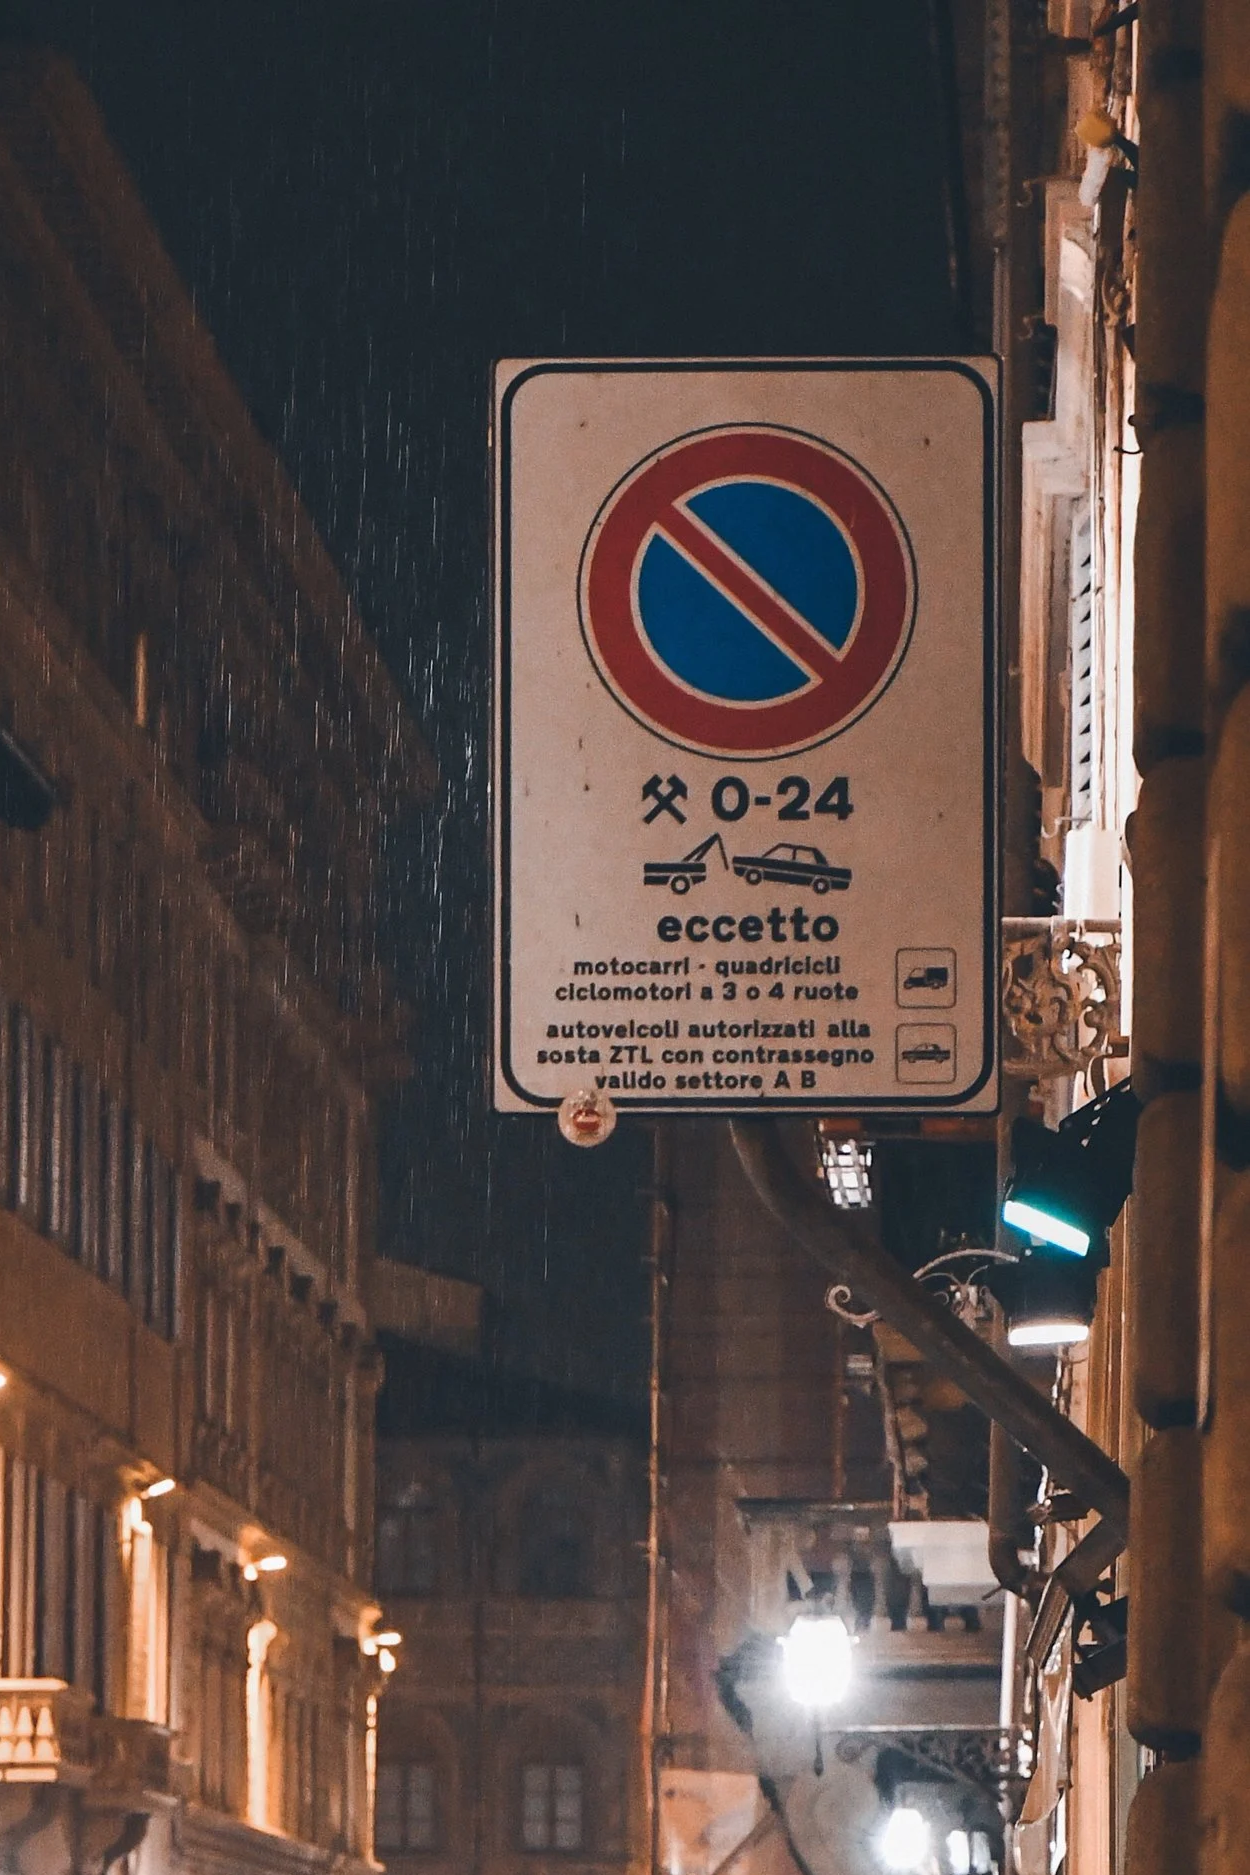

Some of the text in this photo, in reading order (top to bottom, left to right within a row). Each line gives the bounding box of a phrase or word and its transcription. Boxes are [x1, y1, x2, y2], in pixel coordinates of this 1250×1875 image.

[711, 775, 855, 823] 0-24
[656, 906, 840, 943] eccetto
[573, 956, 690, 976] motocarri
[714, 955, 841, 978] quadricicli
[555, 981, 859, 1001] ciclomotori a 3 o 4 ruote
[546, 1019, 871, 1039] autoveicoli autorizzati alla
[536, 1045, 875, 1067] sosta ZTL con contrassegno
[594, 1070, 817, 1090] valido settore A B
